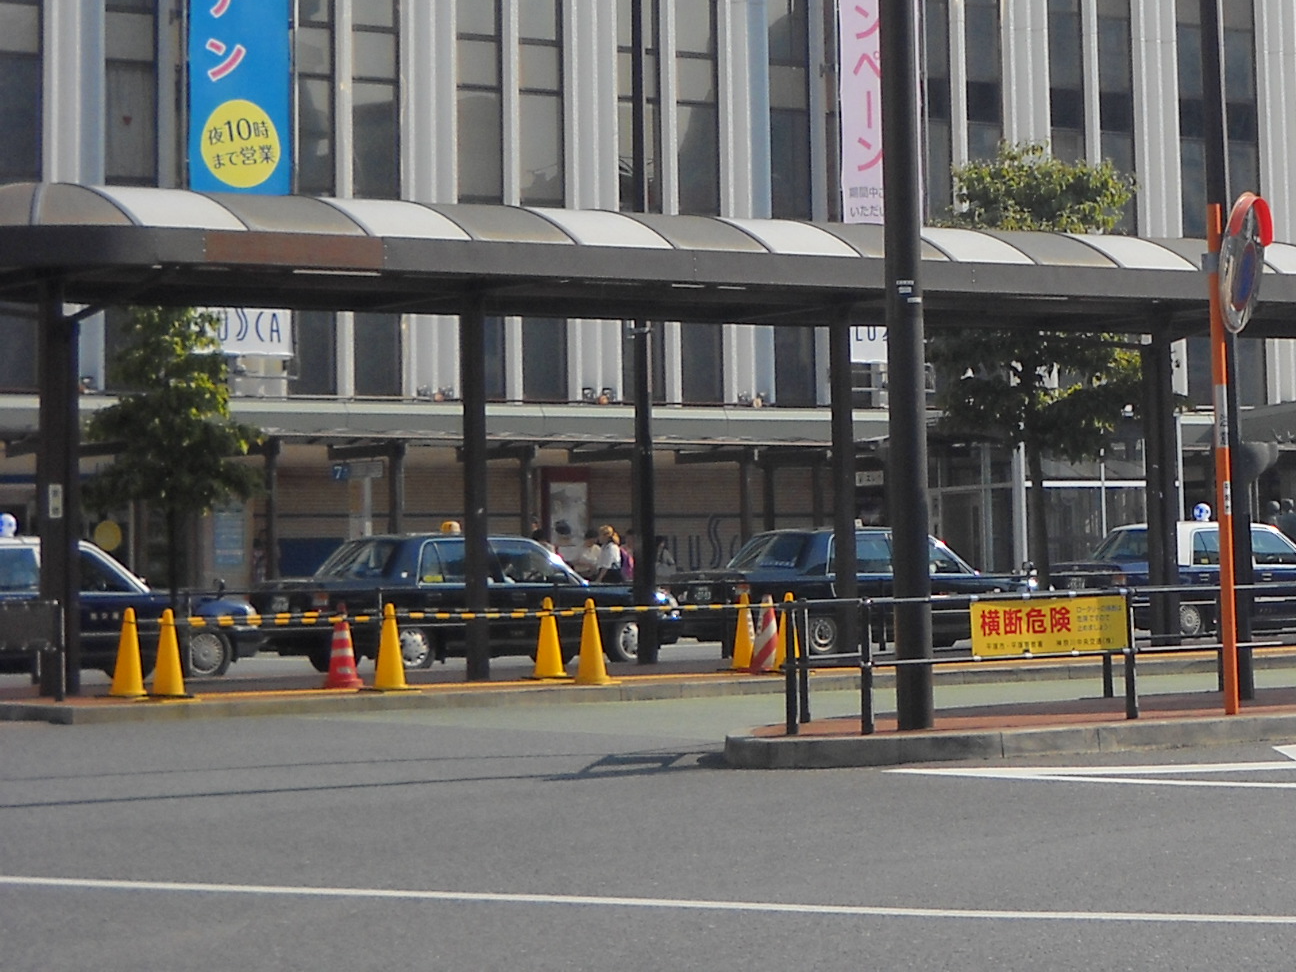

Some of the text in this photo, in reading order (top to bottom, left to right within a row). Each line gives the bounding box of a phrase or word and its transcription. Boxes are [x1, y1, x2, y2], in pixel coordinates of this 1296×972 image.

[208, 117, 269, 146] 夜10時
[212, 144, 276, 170] まで営業
[980, 606, 1072, 637] 横断危険
